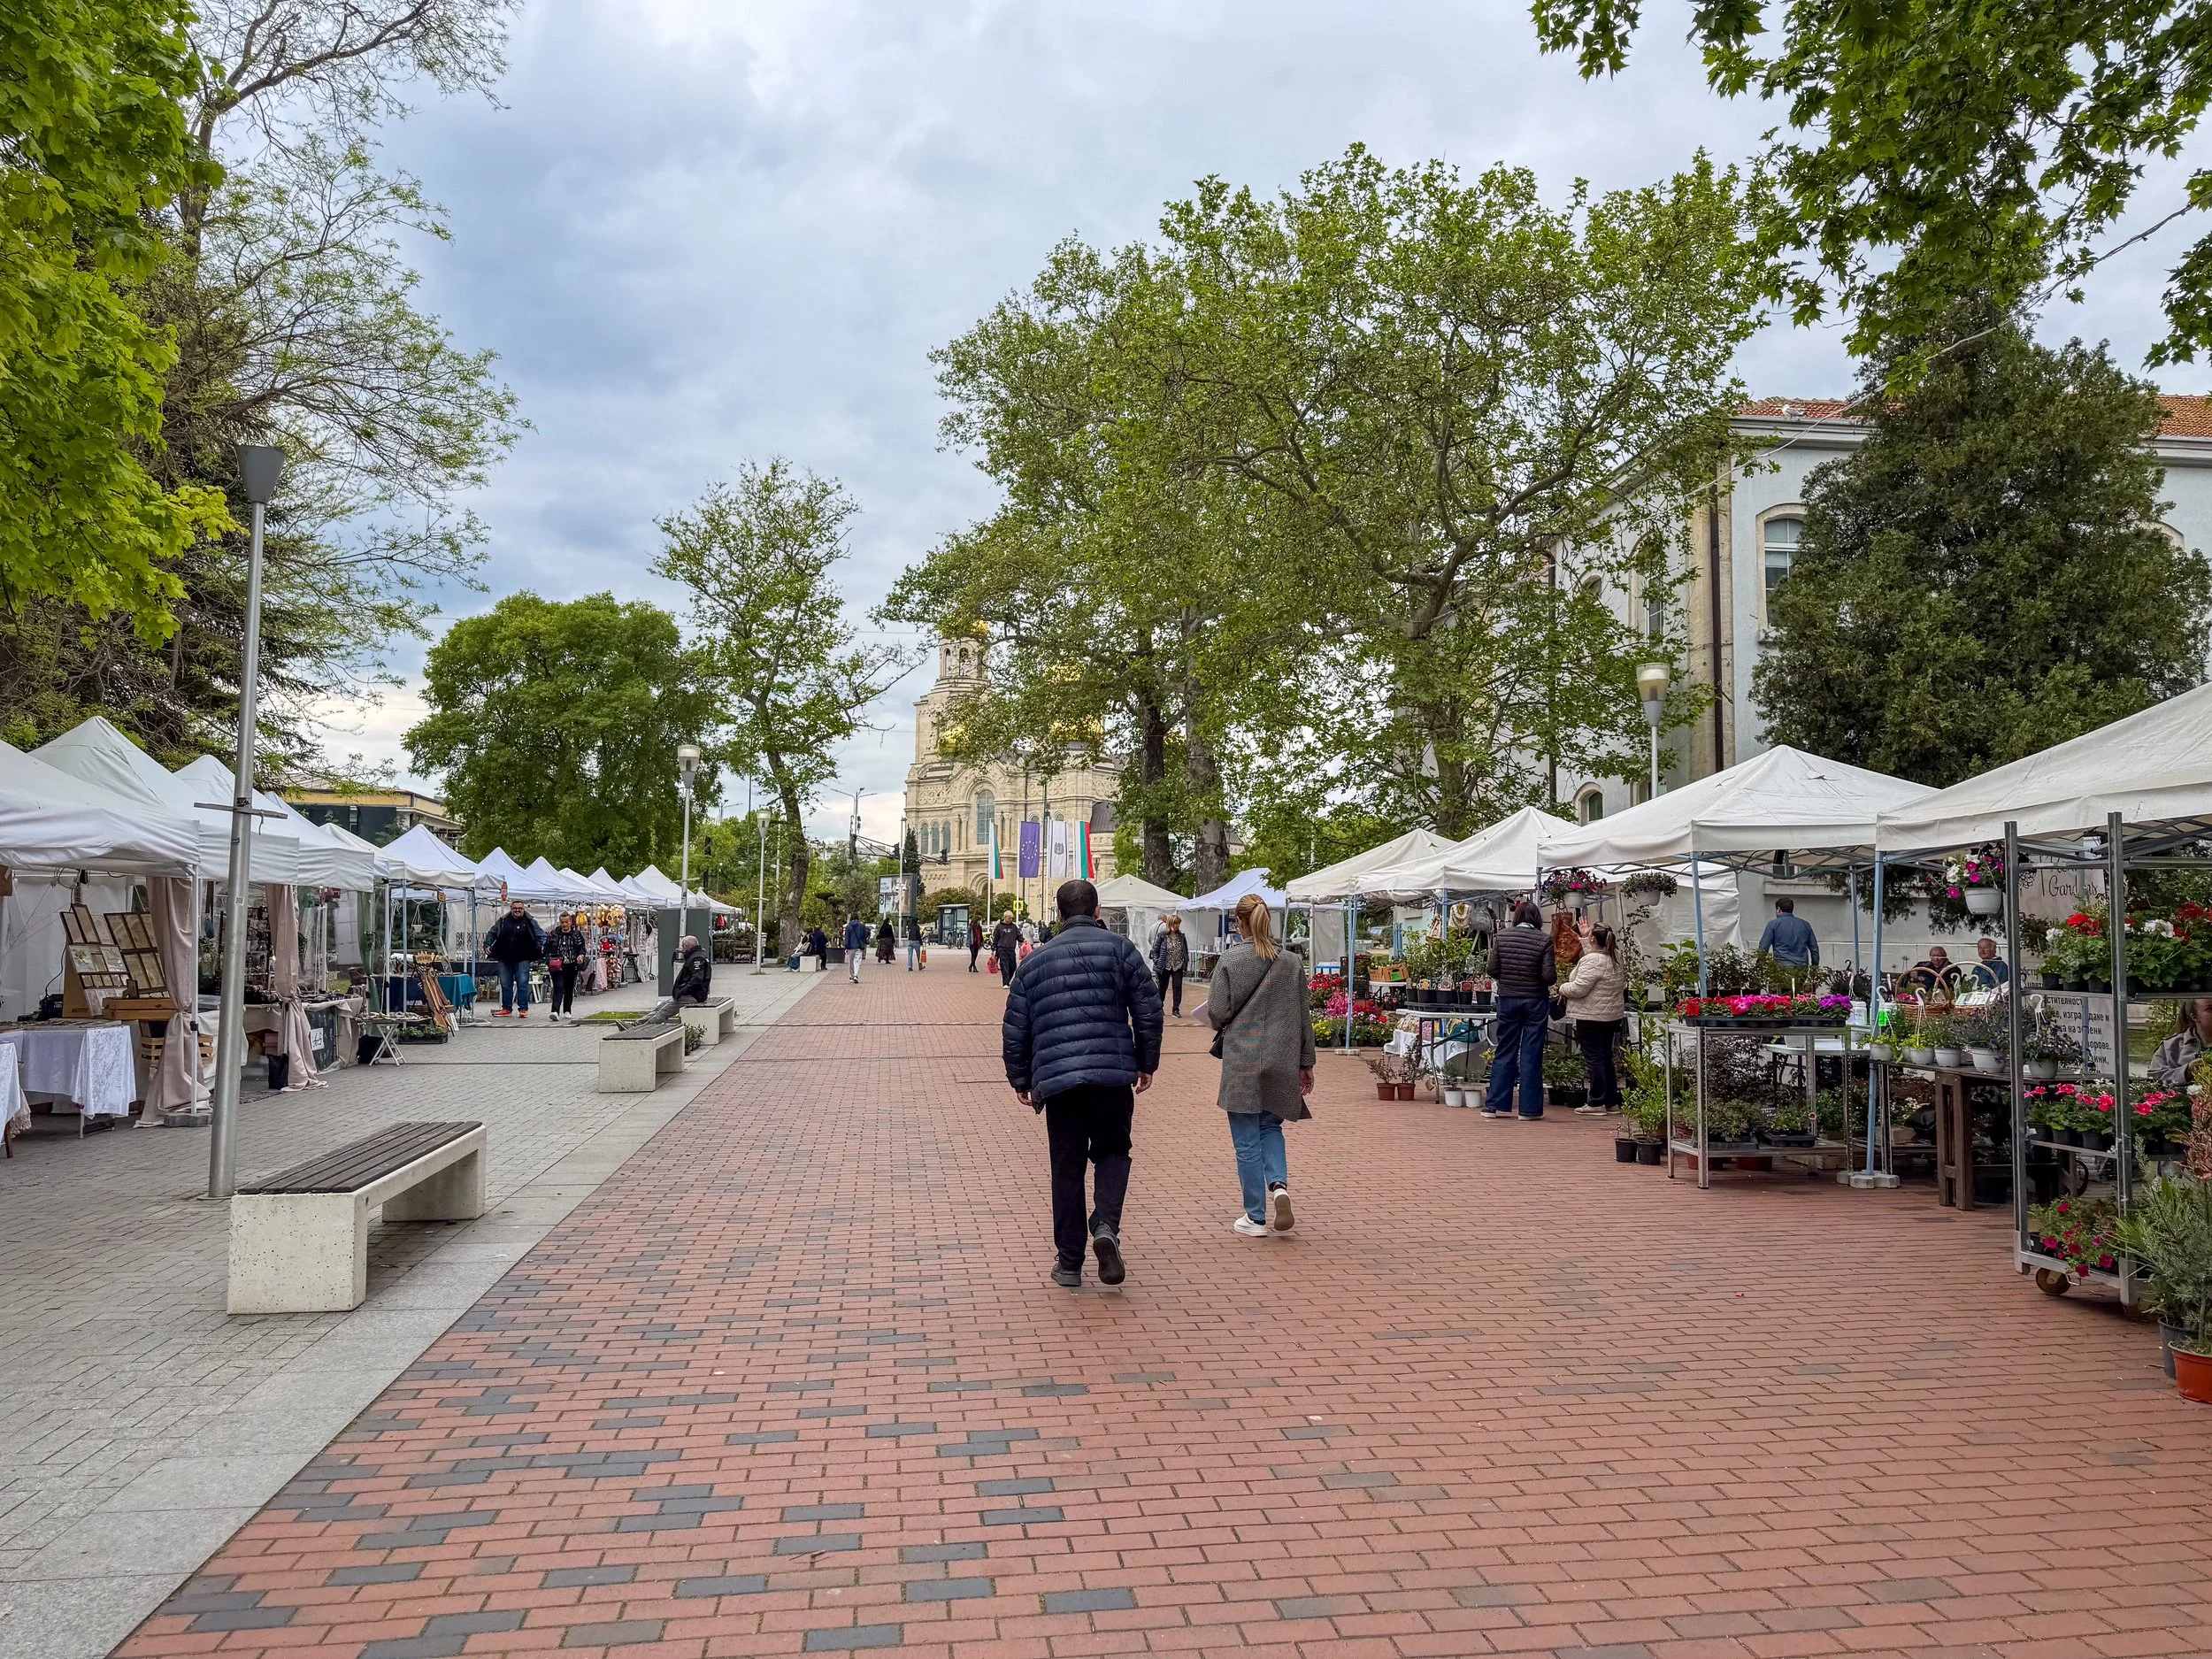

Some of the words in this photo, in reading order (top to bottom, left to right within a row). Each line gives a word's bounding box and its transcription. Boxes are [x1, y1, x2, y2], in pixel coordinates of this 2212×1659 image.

[2048, 875, 2098, 896] Gardns
[2062, 1011, 2104, 1022] изградане
[2077, 1026, 2102, 1035] зени
